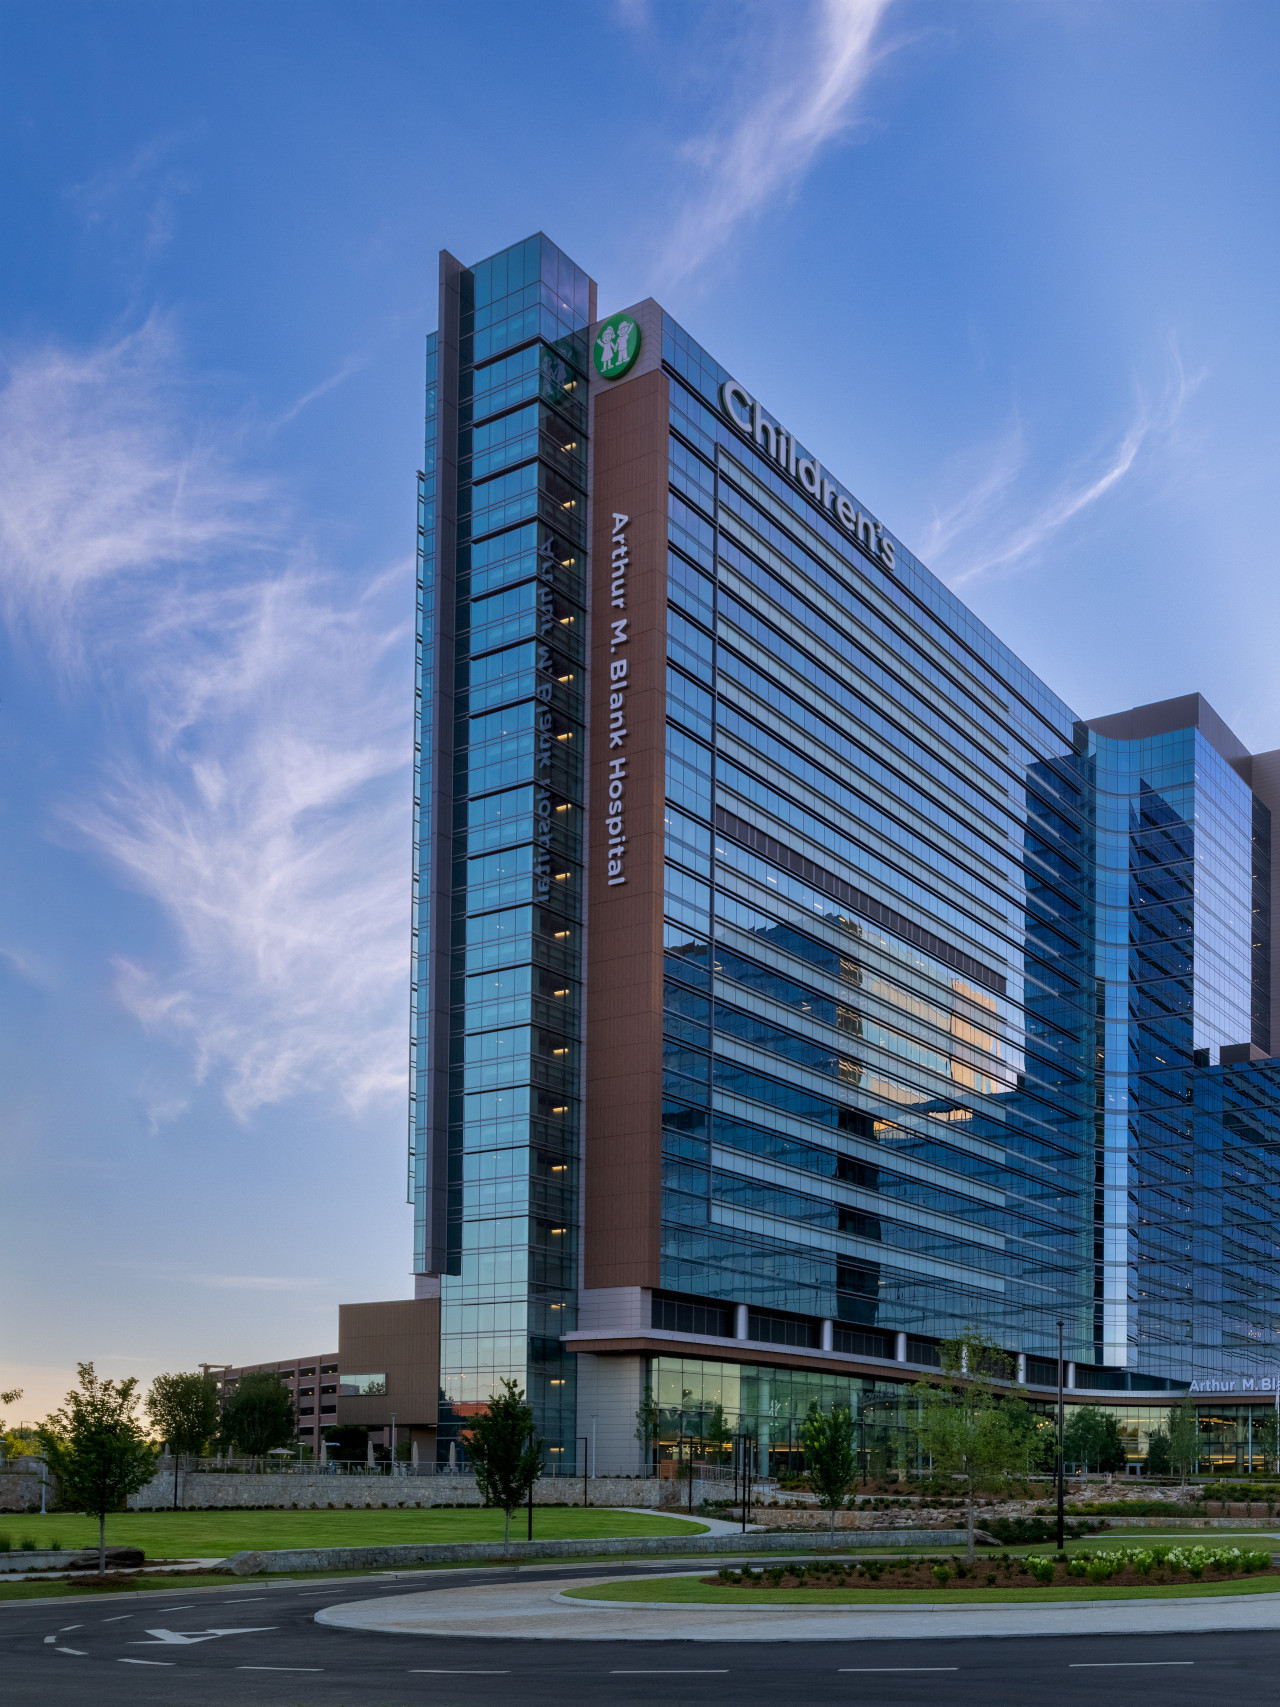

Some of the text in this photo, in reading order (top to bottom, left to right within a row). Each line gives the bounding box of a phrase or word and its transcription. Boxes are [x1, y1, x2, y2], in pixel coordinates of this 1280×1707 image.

[720, 380, 896, 571] Children's
[605, 512, 629, 886] Arthur M. Blank Hospital
[1189, 1378, 1236, 1392] Arthur
[1242, 1379, 1259, 1391] M.
